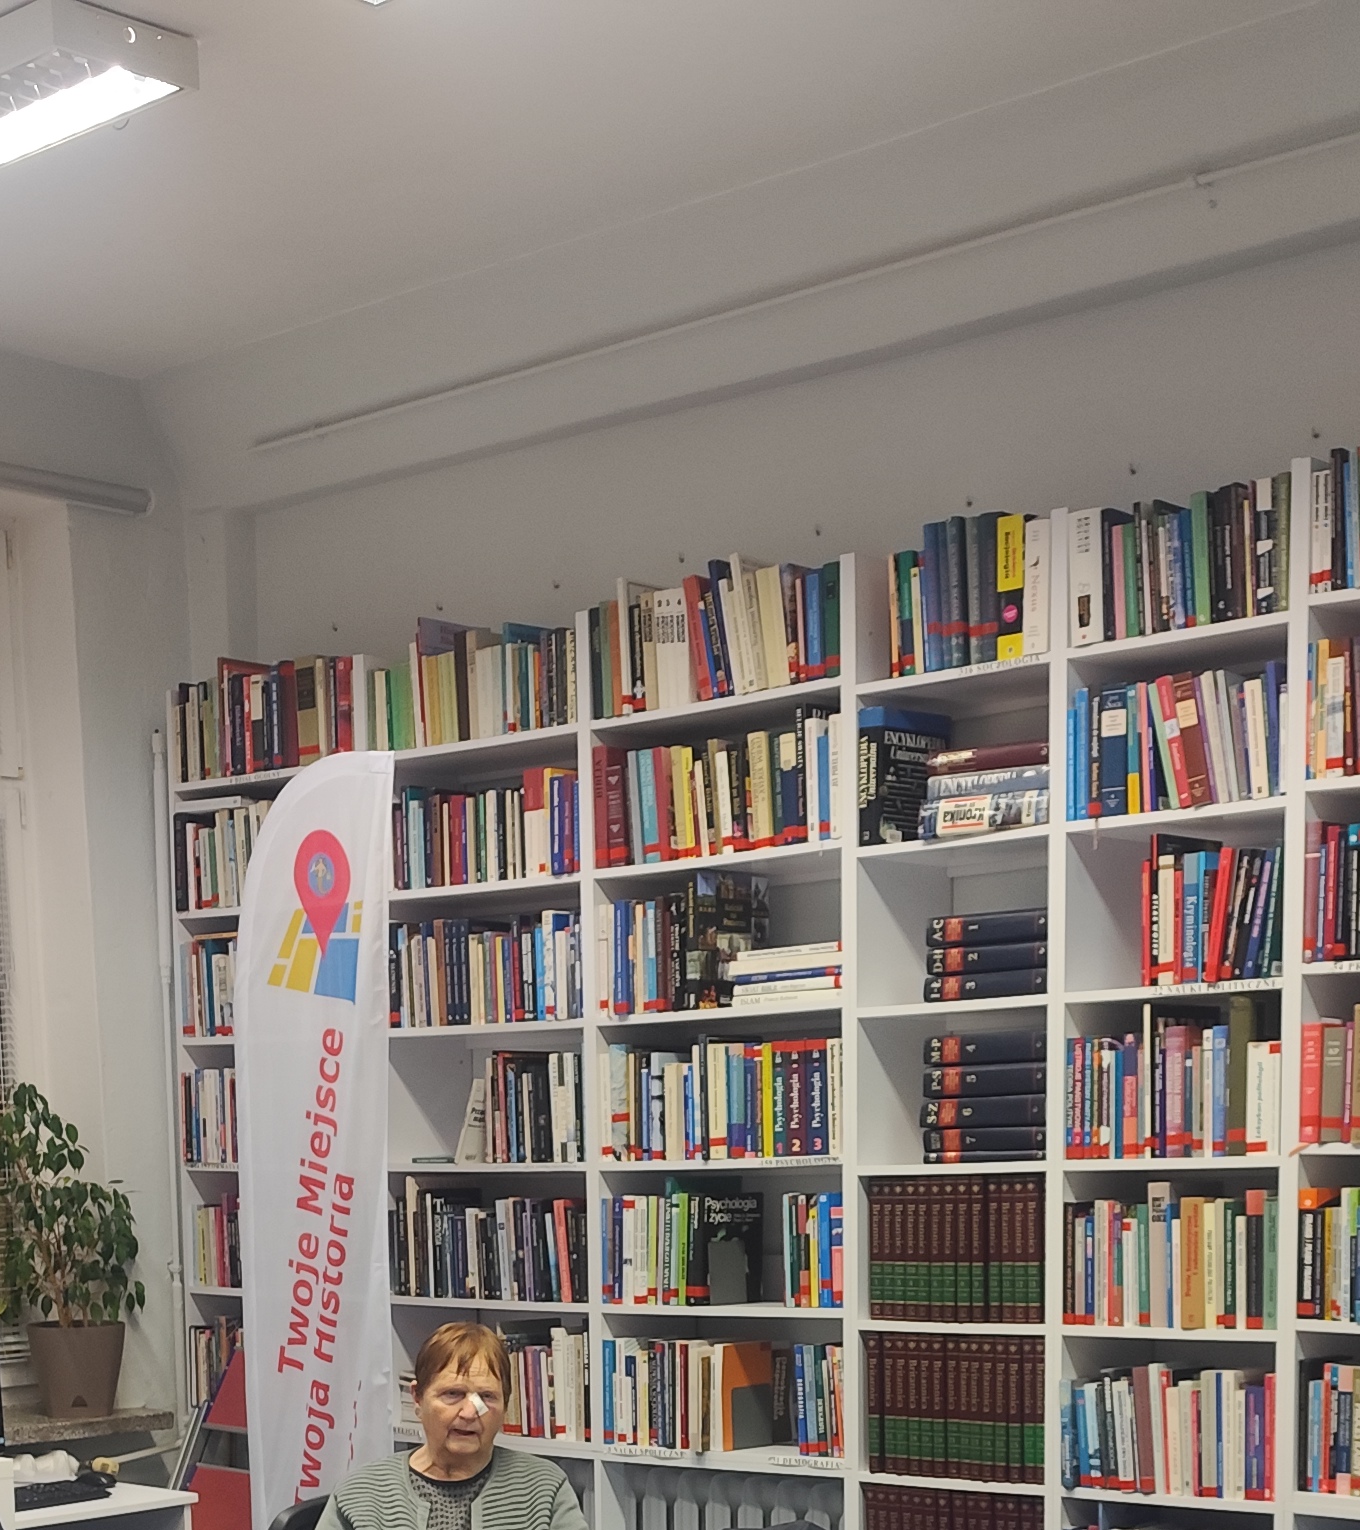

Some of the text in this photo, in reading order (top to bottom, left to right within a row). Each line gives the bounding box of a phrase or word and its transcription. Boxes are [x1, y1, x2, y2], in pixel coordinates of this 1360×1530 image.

[1030, 573, 1041, 614] Nexus
[976, 654, 1041, 673] SOCJOLOGIA
[942, 810, 986, 824] Kronika
[932, 919, 945, 942] A-C
[1184, 895, 1199, 969] Kryminologia
[932, 948, 979, 974] D-H 2
[965, 980, 977, 990] 3
[1166, 978, 1280, 996] NAUKI POLITYCZNE
[930, 1037, 977, 1064] M-P 4
[931, 1069, 943, 1092] P-S
[774, 1076, 784, 1134] Psychologia
[790, 1071, 802, 1153] Psychologia 2
[810, 1071, 823, 1152] Psychologia 3
[926, 1101, 973, 1125] S-Z 6
[965, 1135, 977, 1145] 7
[277, 1026, 346, 1375] Twoje Miejsce
[703, 1197, 758, 1212] Psychologia
[709, 1210, 733, 1225] życie
[293, 1171, 357, 1505] Twoja Historia
[781, 1457, 842, 1470] DEMOGRAFIA
